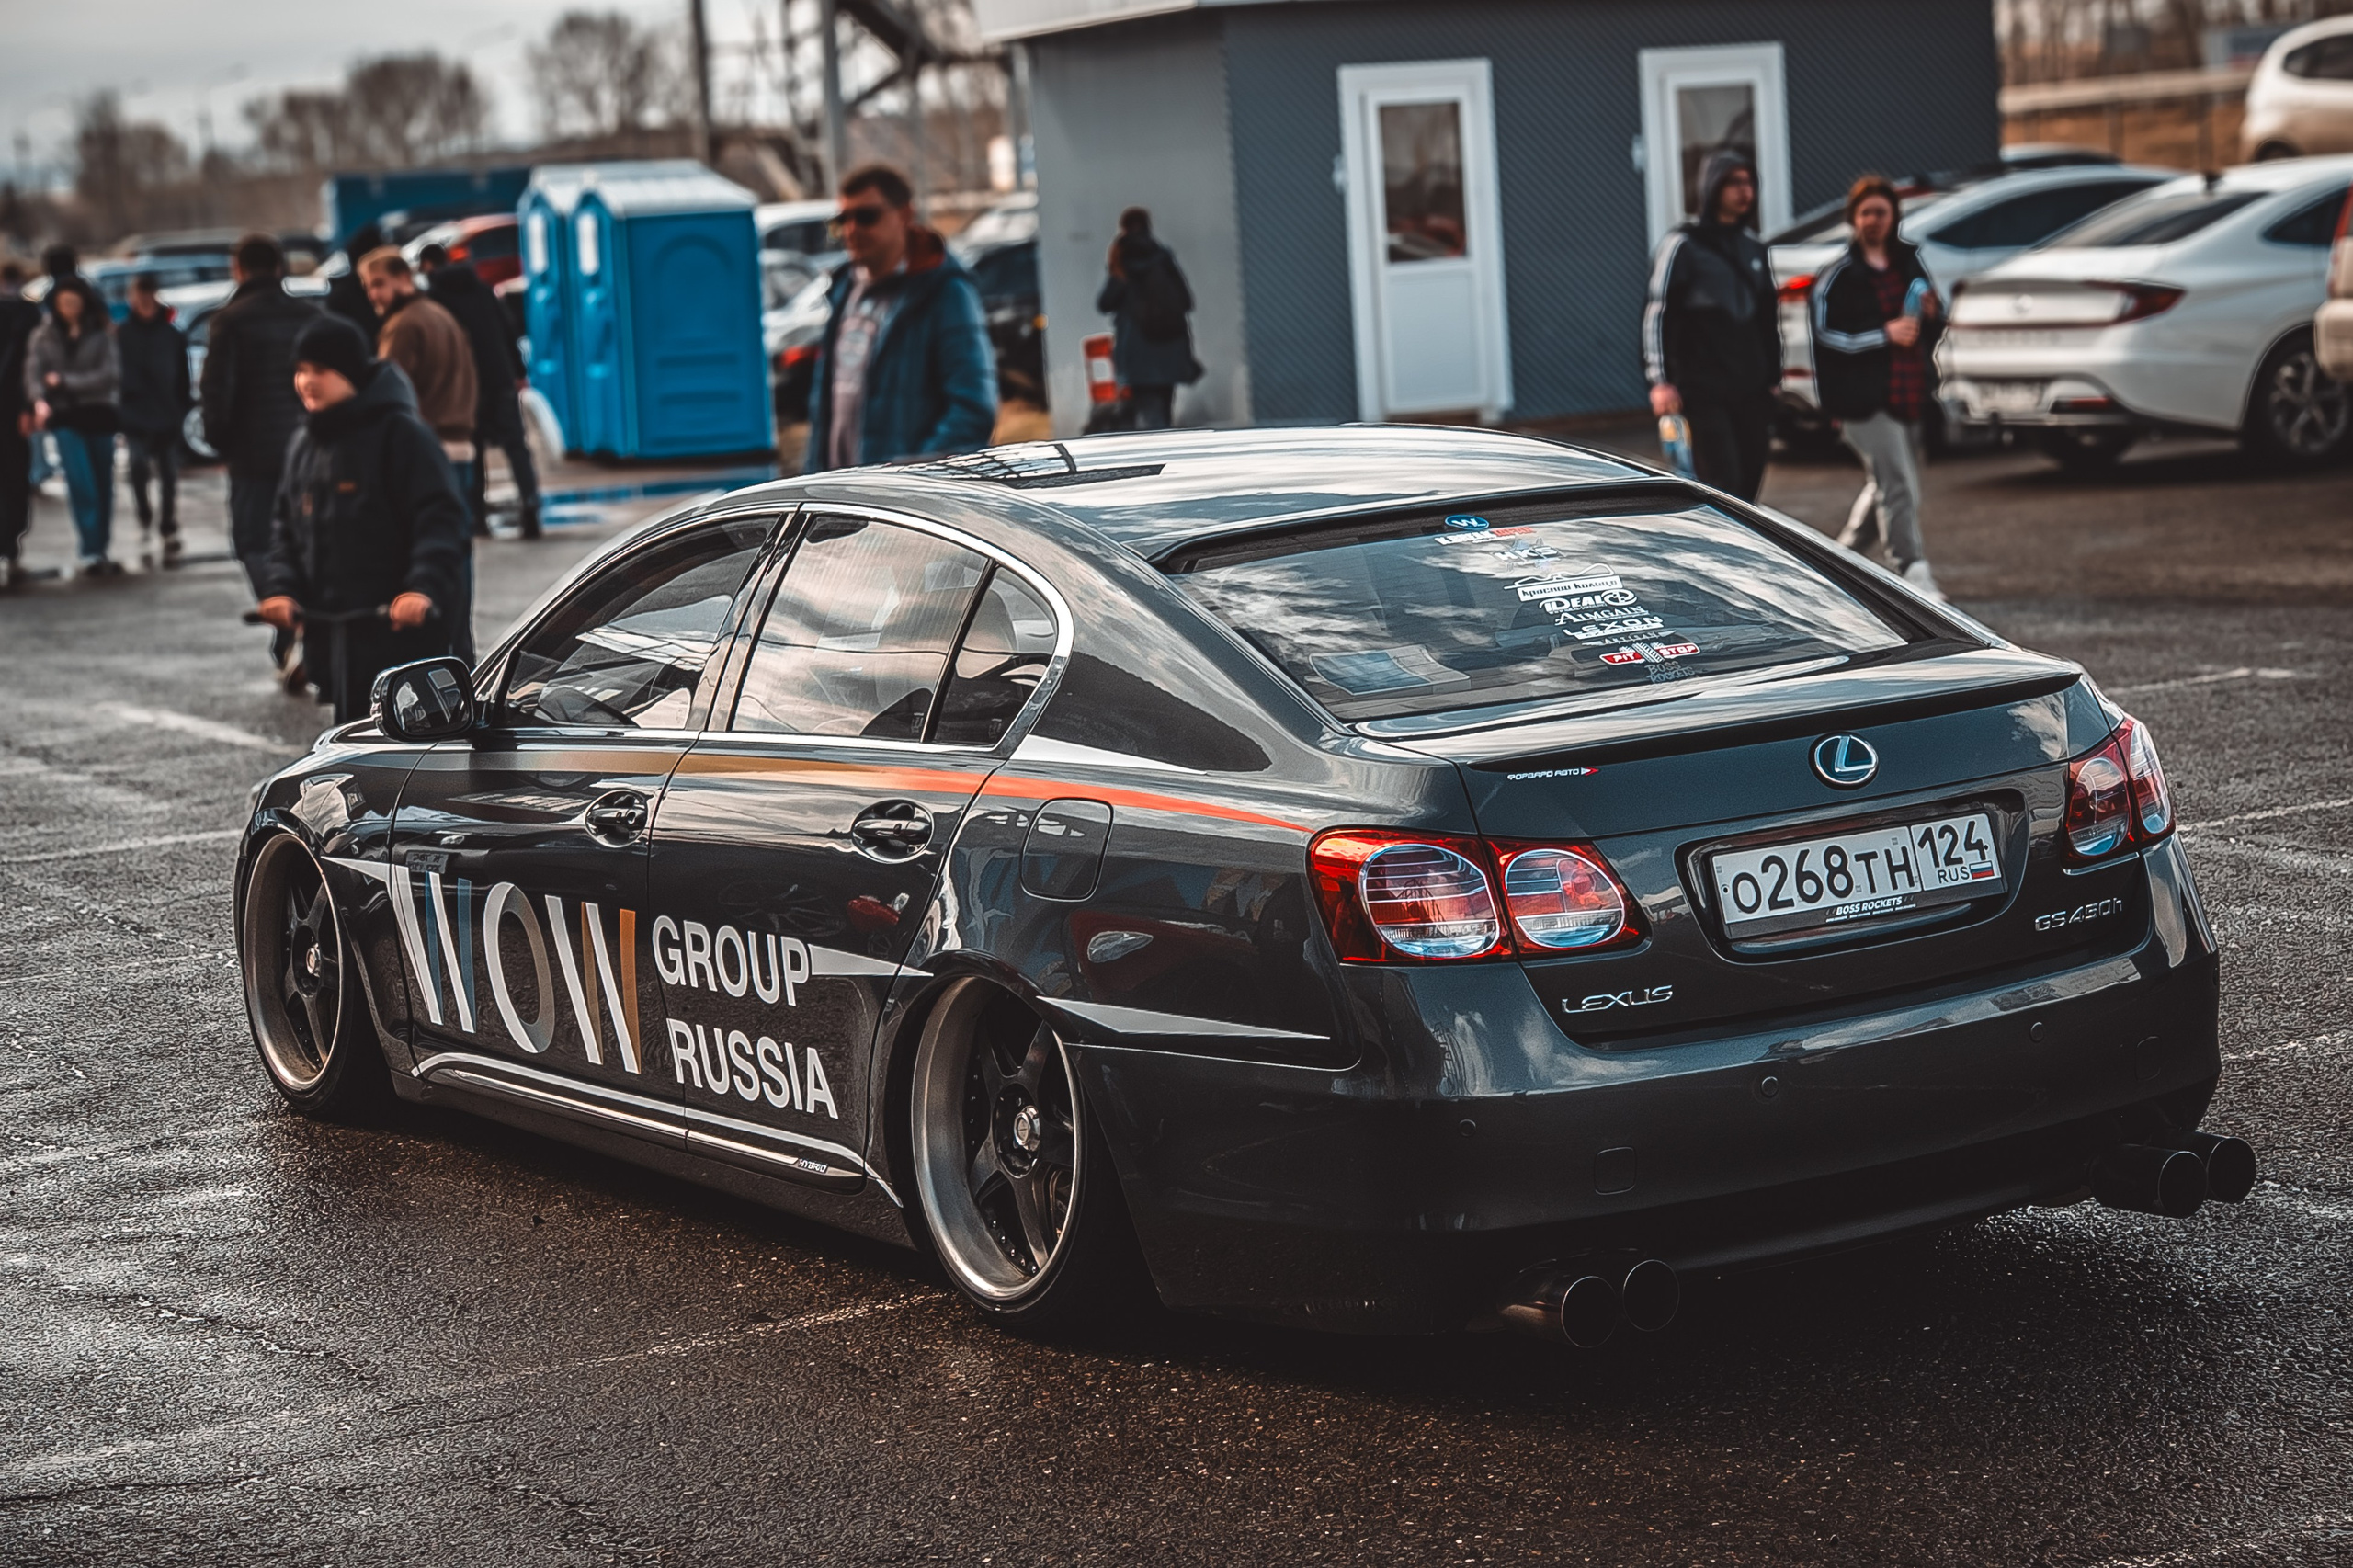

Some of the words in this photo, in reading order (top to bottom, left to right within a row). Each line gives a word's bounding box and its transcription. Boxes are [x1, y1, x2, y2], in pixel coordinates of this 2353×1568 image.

[1494, 546, 1558, 560] HKS
[1563, 616, 1664, 636] LEXON
[1613, 653, 1635, 663] PIT
[1660, 644, 1697, 657] STOP
[1917, 821, 1986, 868] 124
[1938, 866, 1971, 884] RUS
[1836, 903, 1860, 915] BOSS
[1861, 896, 1903, 911] ROCKETS
[392, 862, 642, 1074] WOW
[652, 915, 810, 1006] GROUP
[1562, 985, 1673, 1013] LEXUS
[666, 1017, 838, 1119] RUSSIA
